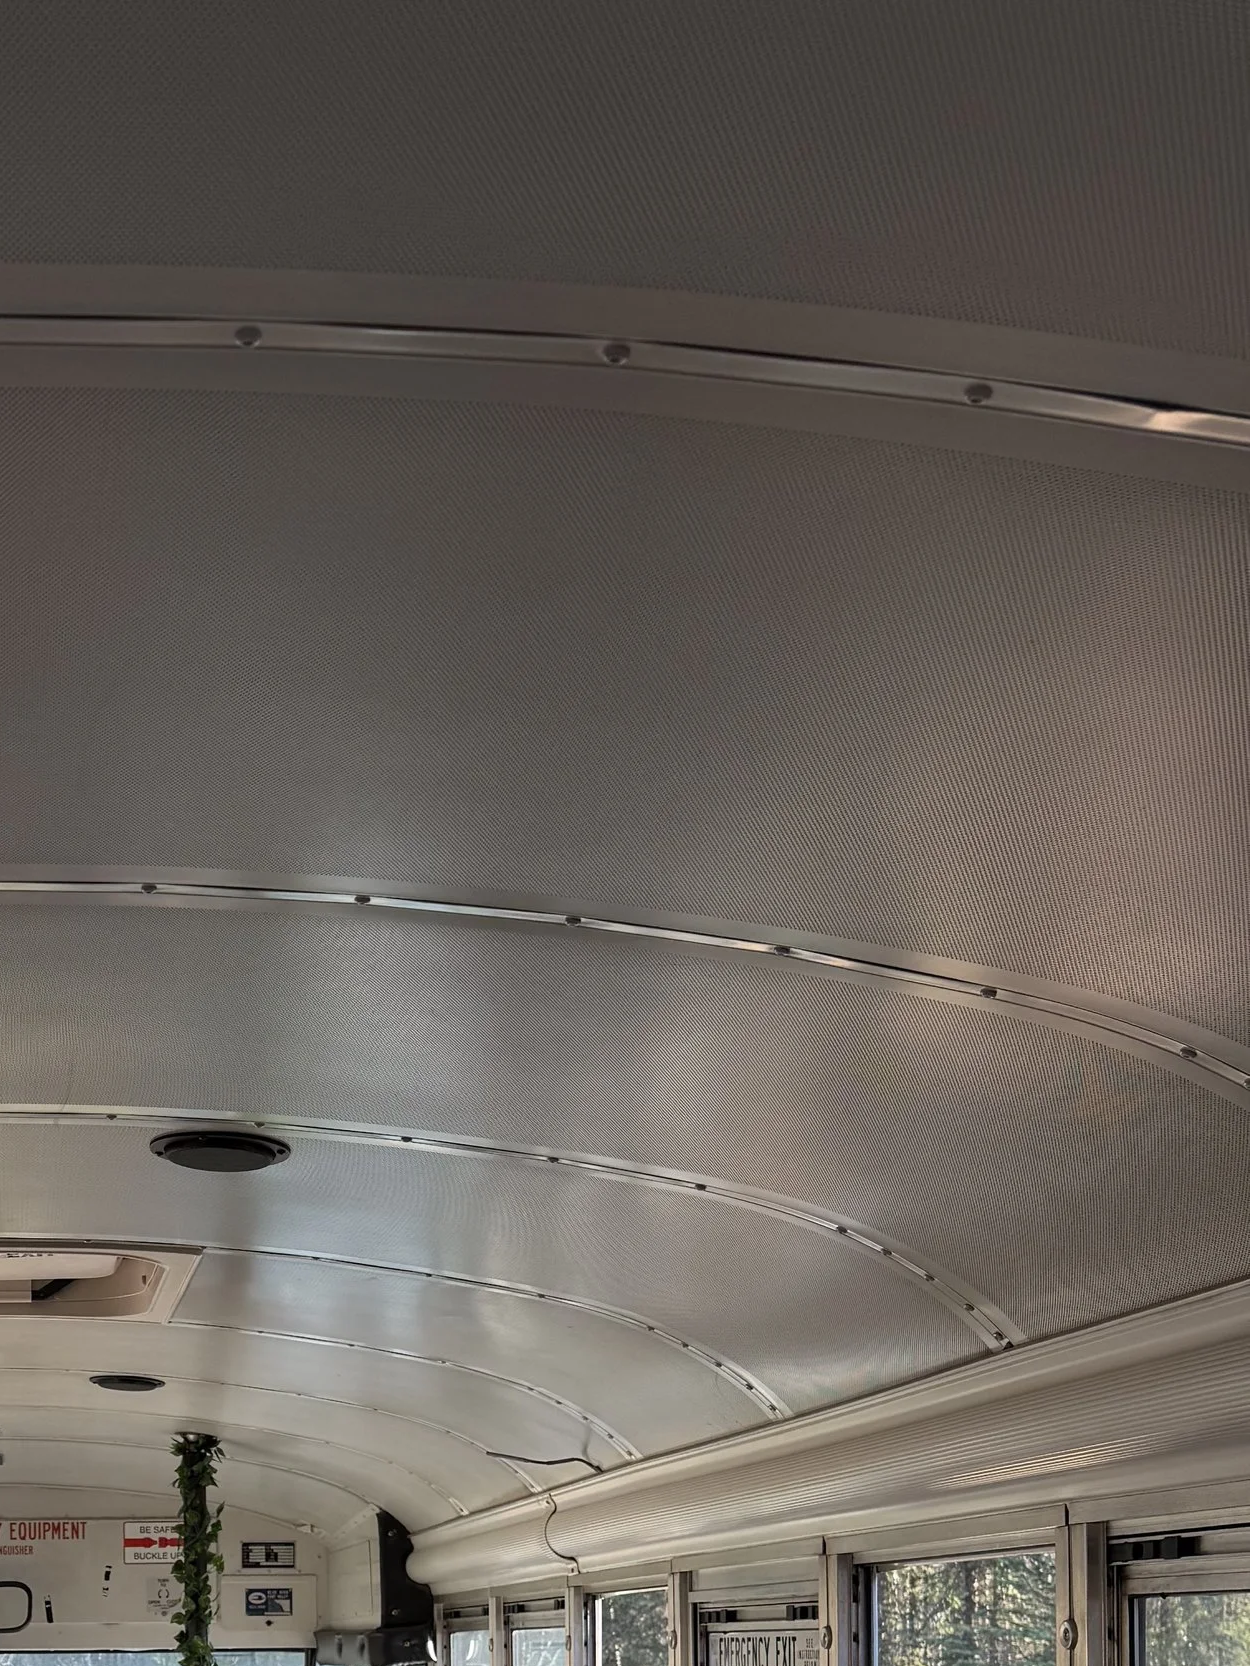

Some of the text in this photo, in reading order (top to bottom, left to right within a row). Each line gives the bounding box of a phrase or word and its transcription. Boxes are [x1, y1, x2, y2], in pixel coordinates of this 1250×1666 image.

[9, 1521, 87, 1540] EQUIPMENT
[139, 1526, 151, 1534] BE
[133, 1552, 168, 1560] BUCKLE
